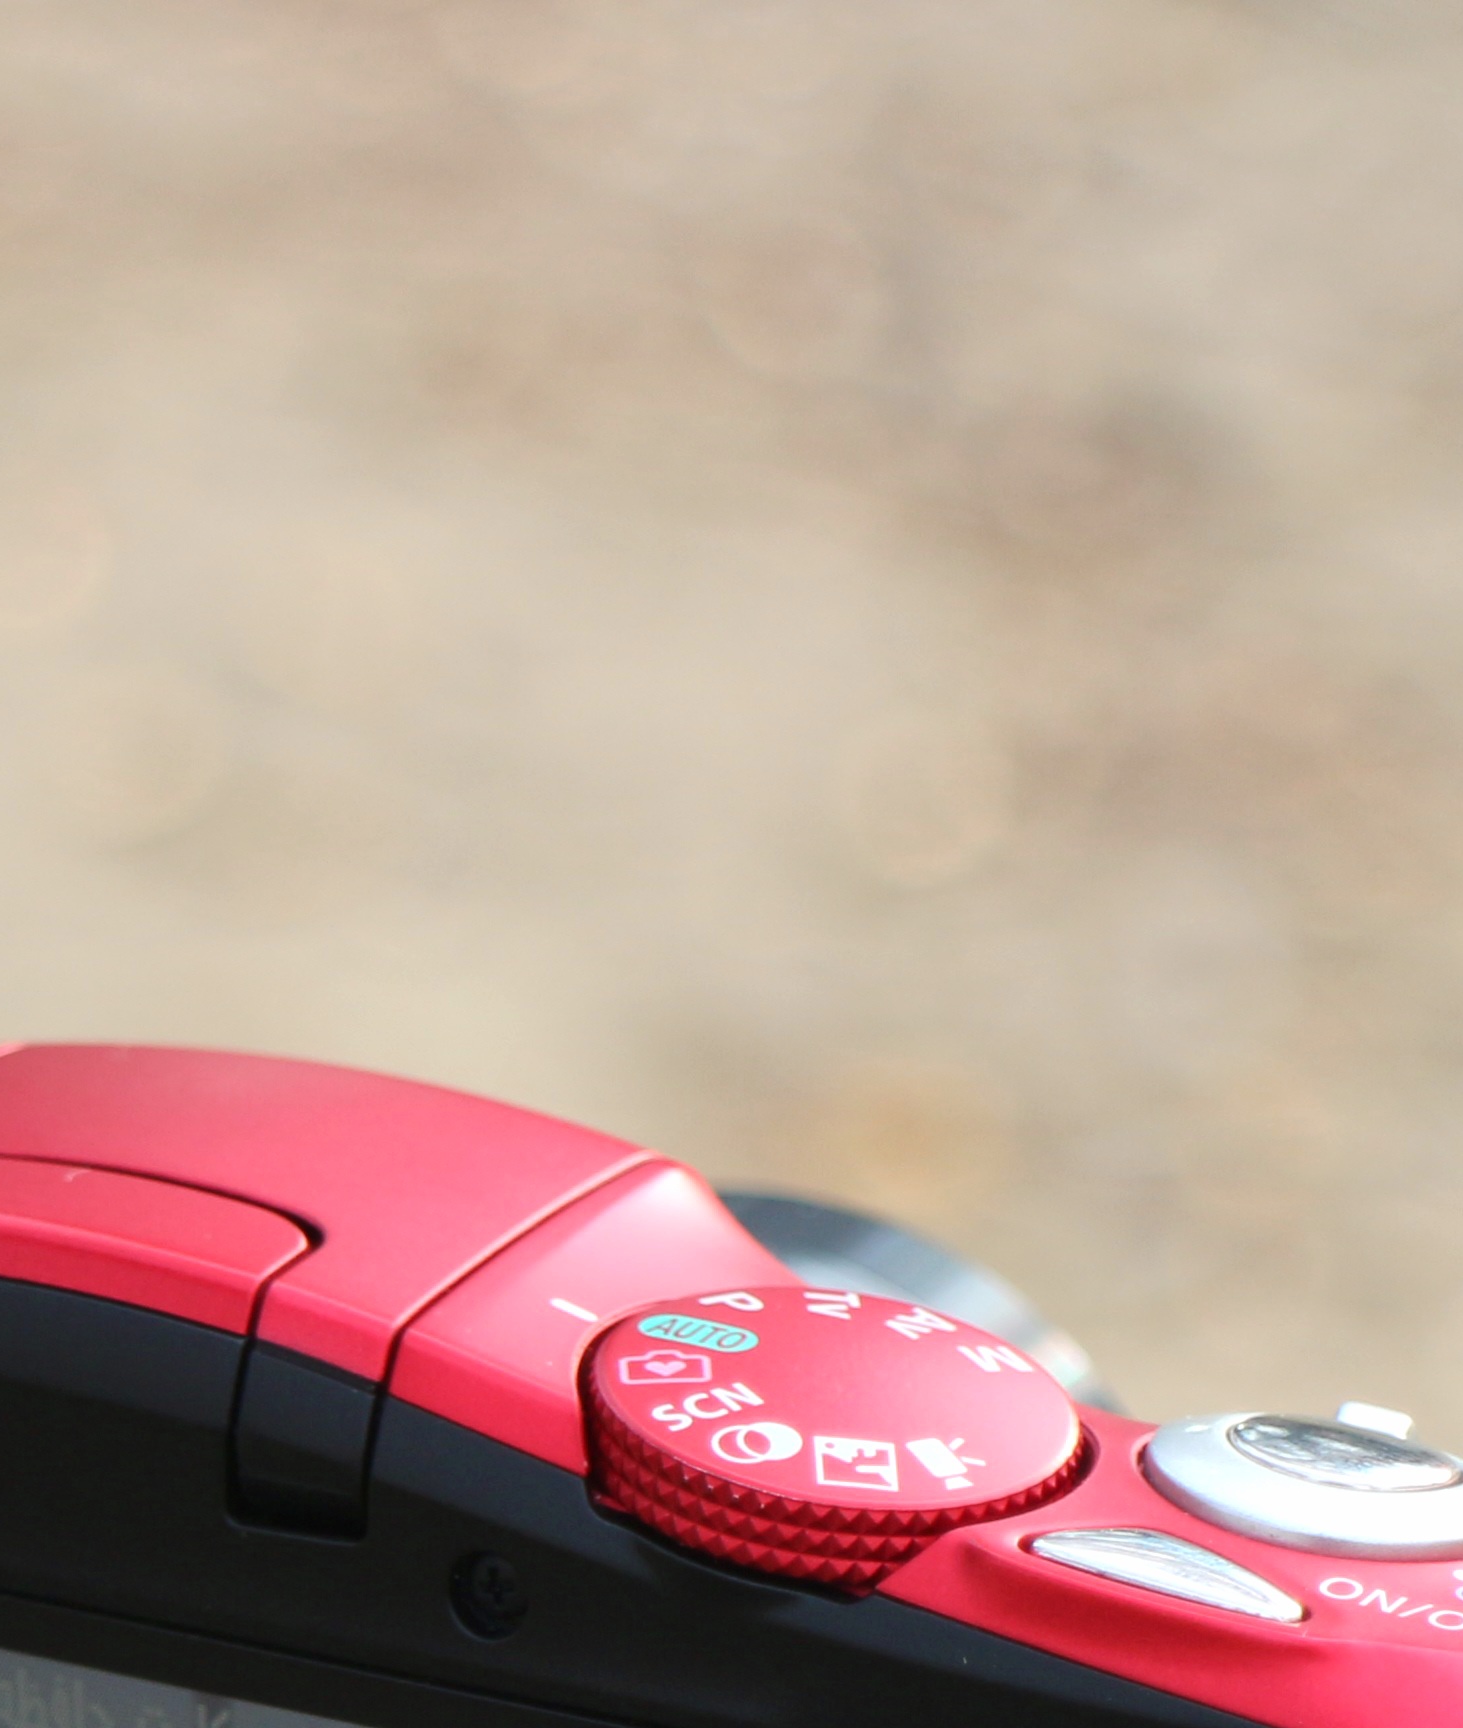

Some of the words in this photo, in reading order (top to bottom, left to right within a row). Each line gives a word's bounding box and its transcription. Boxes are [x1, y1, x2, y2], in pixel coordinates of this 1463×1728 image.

[699, 1291, 765, 1312] P
[803, 1291, 862, 1320] Tv
[647, 1316, 749, 1350] AUTO
[885, 1306, 957, 1340] Av
[957, 1345, 1034, 1373] M
[651, 1382, 765, 1432] SCN
